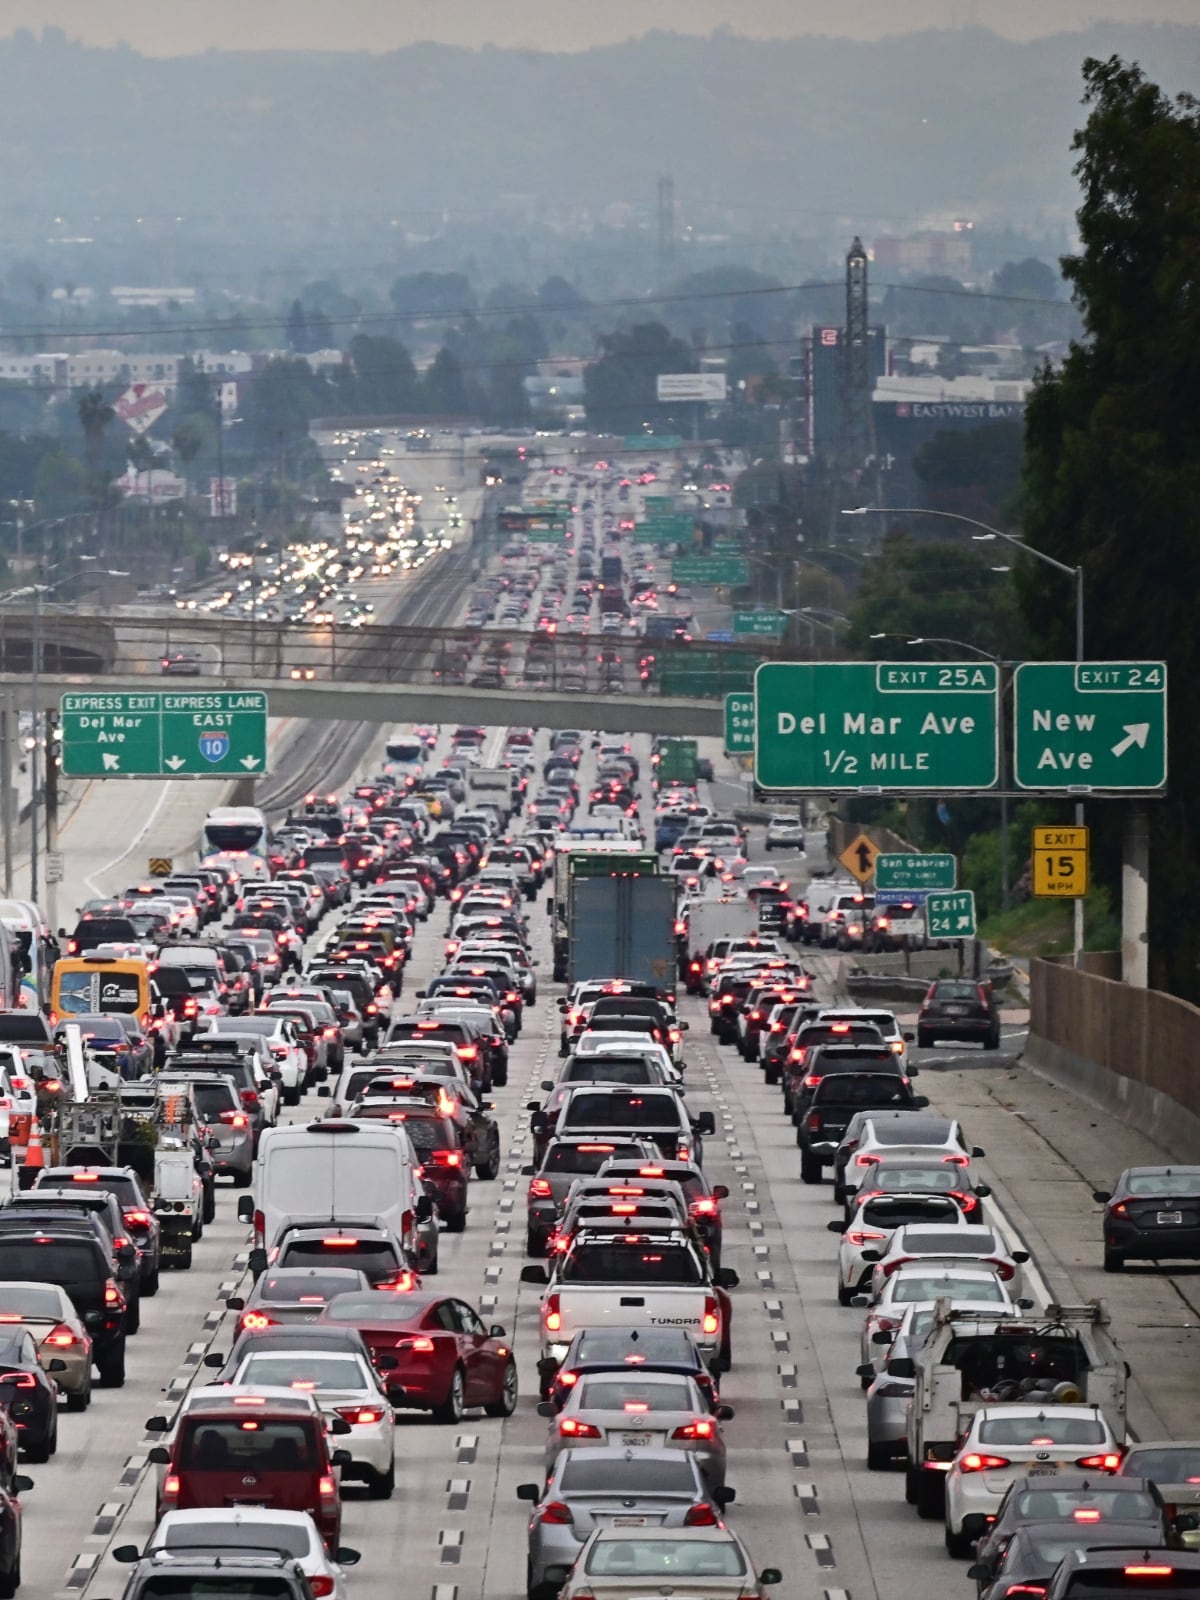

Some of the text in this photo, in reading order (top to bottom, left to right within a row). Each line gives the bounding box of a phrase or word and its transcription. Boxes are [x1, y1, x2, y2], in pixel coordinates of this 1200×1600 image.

[888, 669, 987, 686] EXIT 25A
[1081, 669, 1161, 686] EXIT 24
[65, 697, 156, 710] EXPRESS EXIT
[164, 697, 262, 708] EXPRESS LANE
[731, 702, 753, 712] Del
[80, 716, 142, 728] Del Mar
[193, 714, 233, 726] EAST
[777, 712, 976, 735] Del Mar Ave
[1032, 710, 1096, 732] New
[97, 731, 126, 743] Ave
[205, 741, 223, 756] 10
[870, 753, 929, 770] MILE
[1036, 748, 1094, 770] Ave
[1044, 833, 1077, 845] EXIT
[881, 858, 950, 868] San Gabriel
[1046, 856, 1075, 877] 15
[1047, 882, 1073, 891] MPH
[931, 898, 967, 912] EXIT
[932, 918, 950, 931] 24
